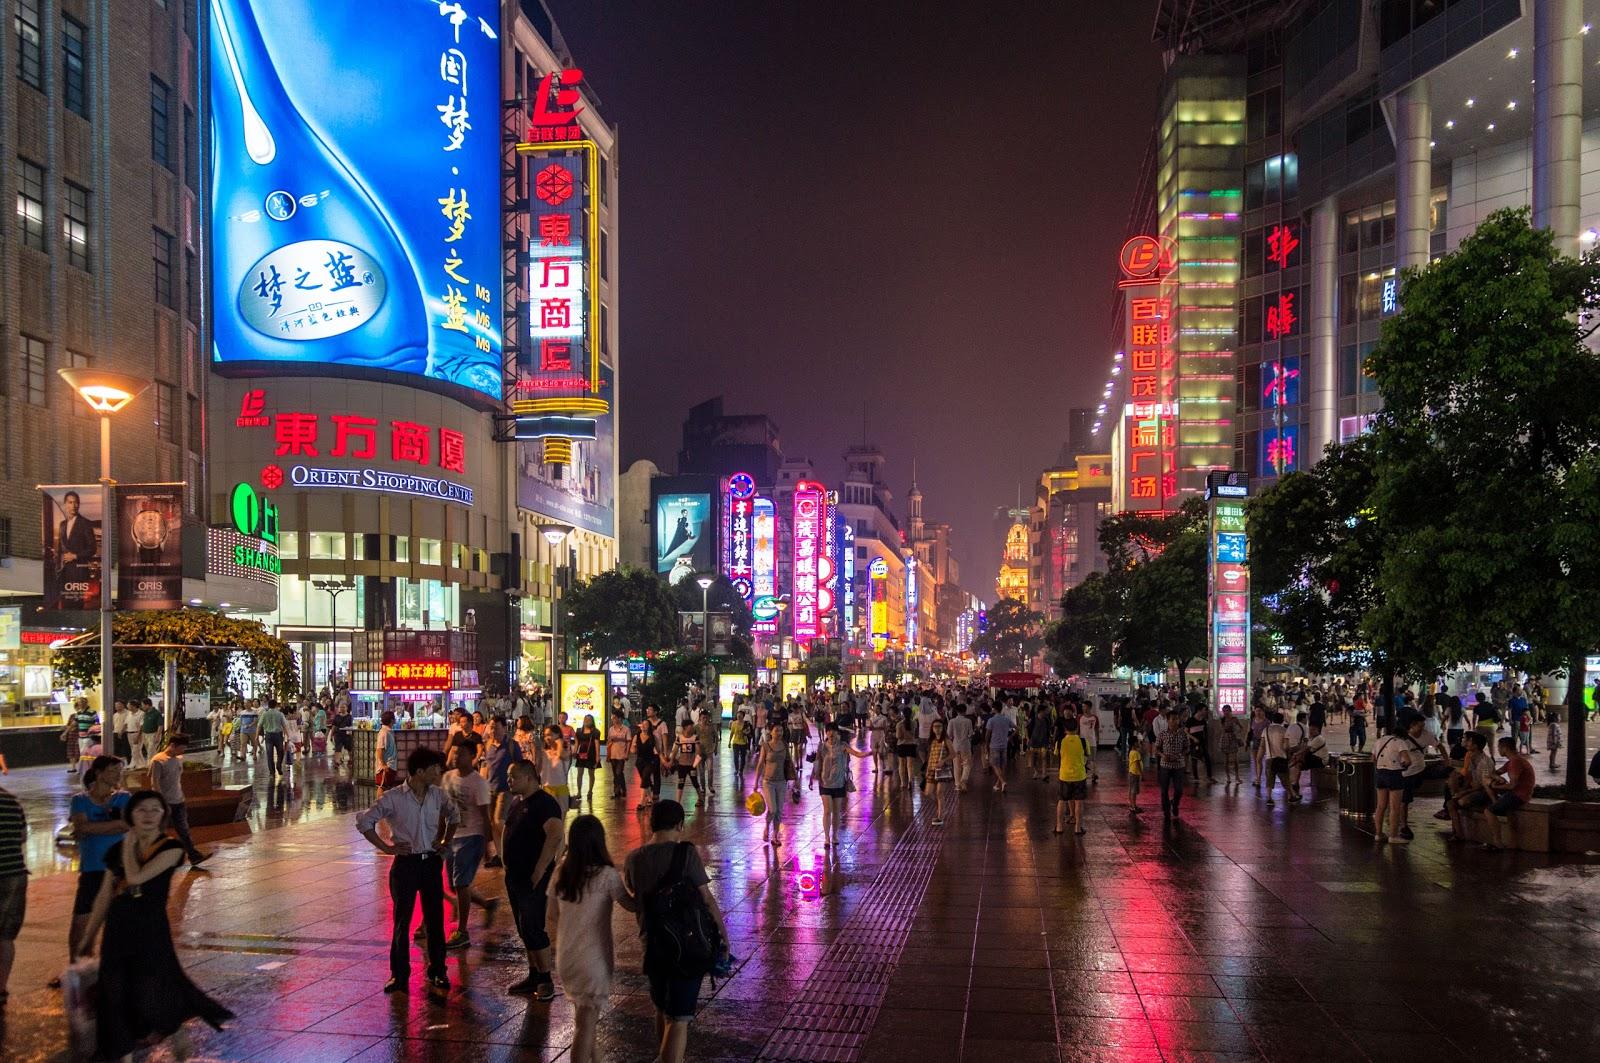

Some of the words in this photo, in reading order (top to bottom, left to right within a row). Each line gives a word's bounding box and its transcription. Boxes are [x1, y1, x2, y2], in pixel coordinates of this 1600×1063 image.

[253, 250, 363, 318] 梦之蓝
[475, 283, 491, 304] M3
[475, 309, 491, 329] M6
[475, 334, 491, 353] M9
[1131, 298, 1158, 498] 百联世茂国际广场
[1221, 516, 1240, 526] SPA
[64, 582, 89, 592] ORIS
[137, 581, 163, 590] ORIS
[385, 664, 448, 679] 黄浦江游船
